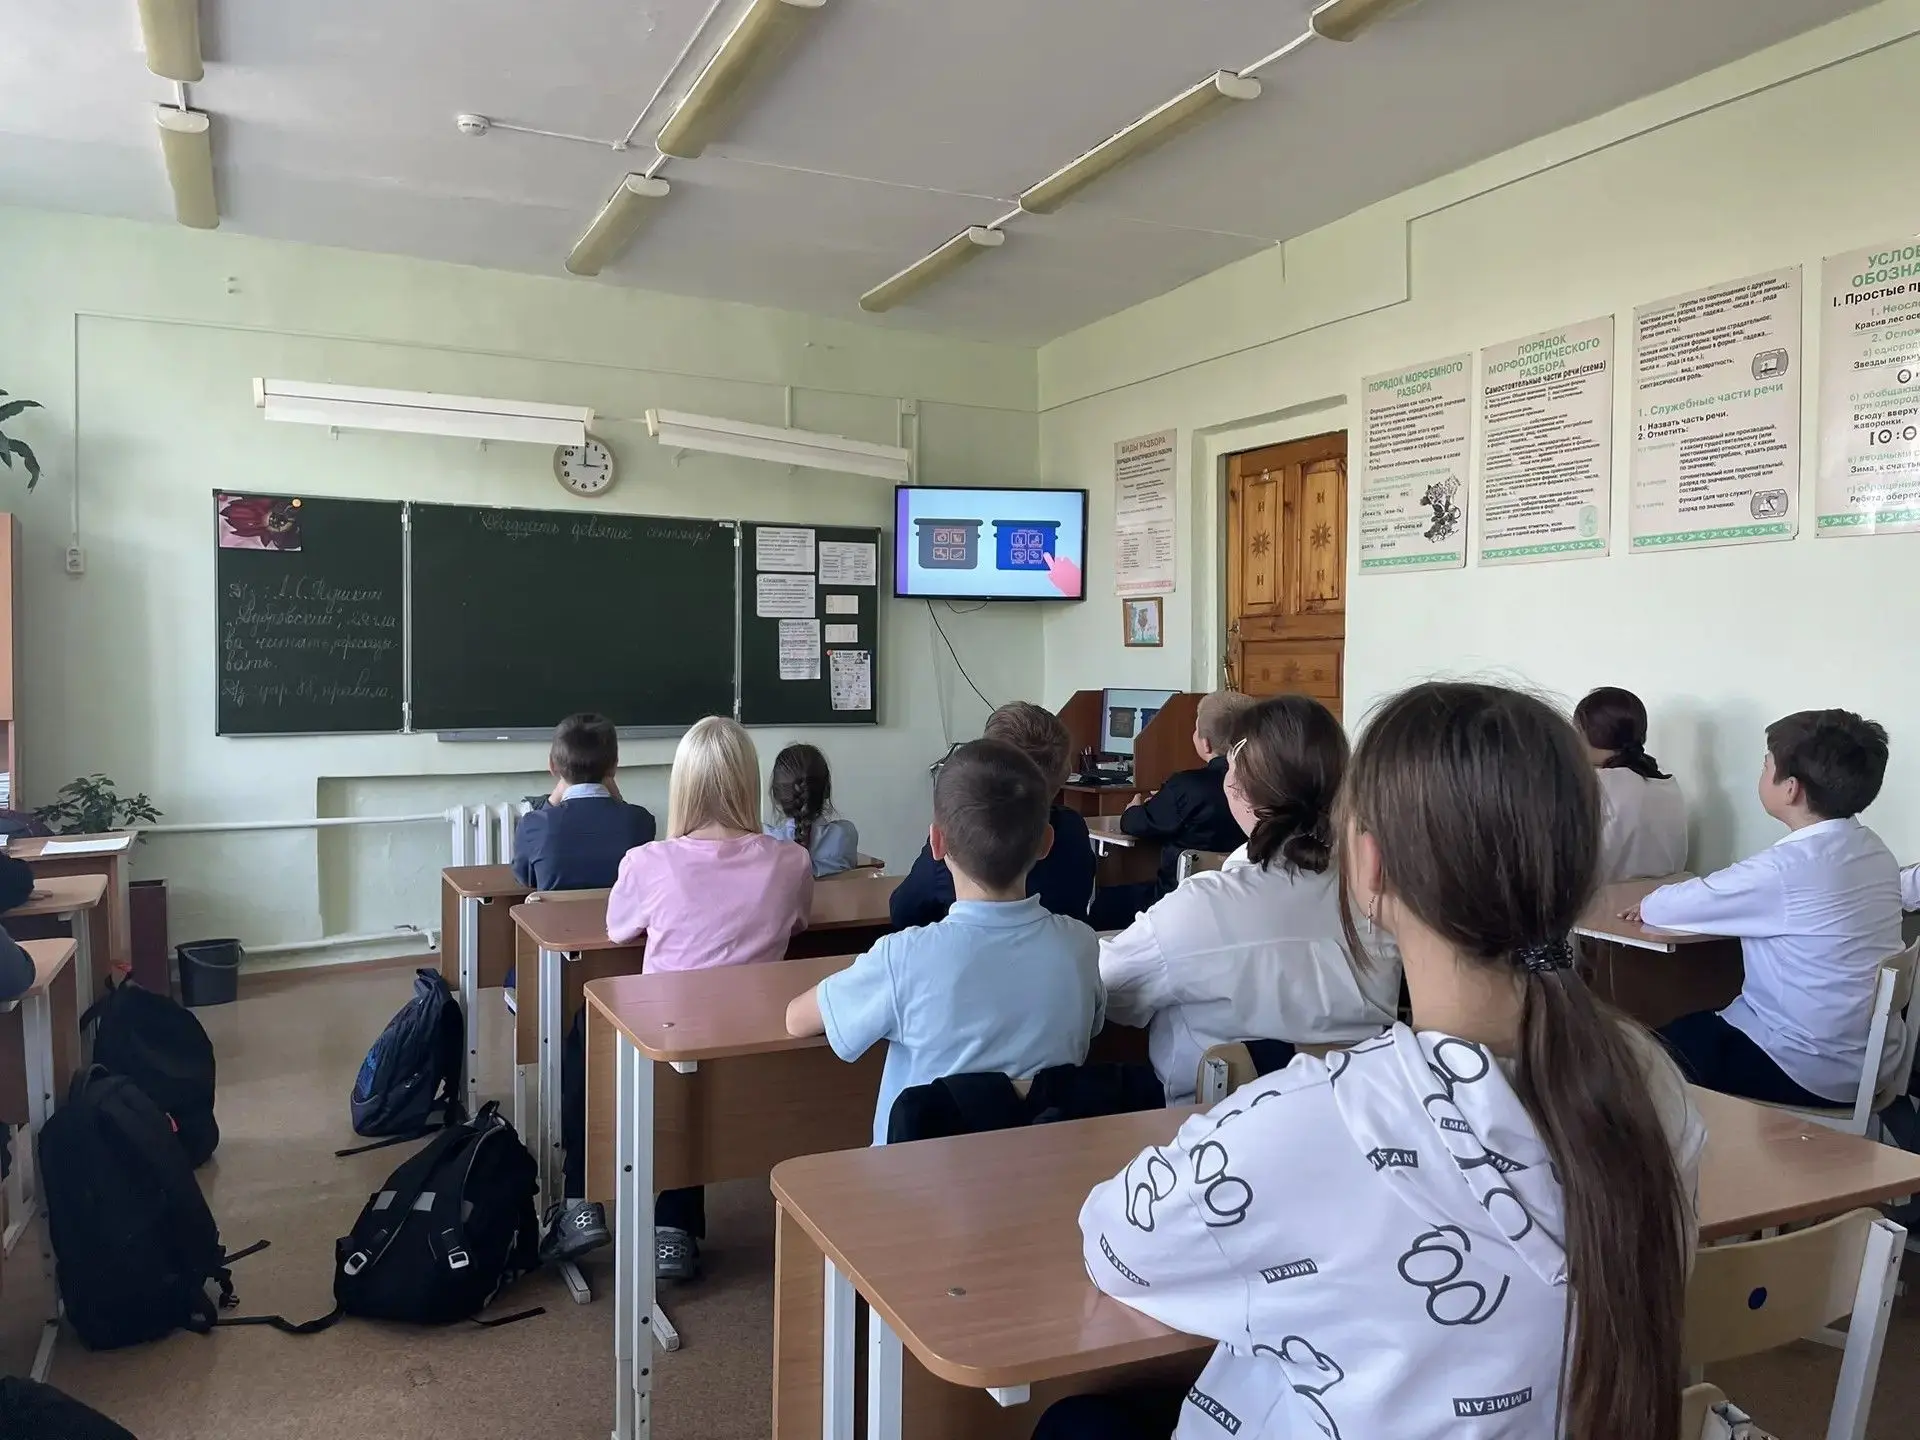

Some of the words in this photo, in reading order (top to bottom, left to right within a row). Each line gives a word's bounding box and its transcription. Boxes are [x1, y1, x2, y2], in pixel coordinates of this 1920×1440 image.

[1846, 285, 1905, 306] Простые
[1883, 300, 1920, 314] Неосл
[1855, 318, 1886, 330] Красив
[1888, 315, 1903, 324] лес
[1517, 334, 1567, 356] ПОРЯДОК
[1872, 334, 1881, 342] 2.
[1488, 338, 1600, 375] МОРФОЛОГИЧЕСКОГО
[1854, 359, 1886, 369] Звезды
[1369, 375, 1403, 393] ПОРЯДОК
[1405, 361, 1463, 384] МОРФЕМНОГО
[1520, 360, 1565, 378] РАЗБОРА
[1397, 382, 1432, 398] РАЗБОРА
[1485, 377, 1542, 395] Самостоятельные
[1543, 372, 1561, 381] части
[1650, 396, 1714, 416] Служебные
[1718, 389, 1750, 402] части
[1754, 383, 1783, 398] речи
[1854, 403, 1872, 411] при
[1648, 419, 1680, 431] Назвать
[1681, 415, 1704, 424] часть
[1706, 411, 1728, 421] речи.
[1854, 412, 1885, 421] Всюду:
[1888, 408, 1918, 416] вверху
[1854, 419, 1904, 429] жаворонки.
[1648, 427, 1688, 439] Отметить:
[1851, 465, 1876, 473] Зима,
[1443, 1120, 1473, 1133] LMM
[1265, 1260, 1316, 1281] LMMEAN
[1188, 1386, 1237, 1430] MMEAN
[1459, 1391, 1530, 1413] LMMEAN
